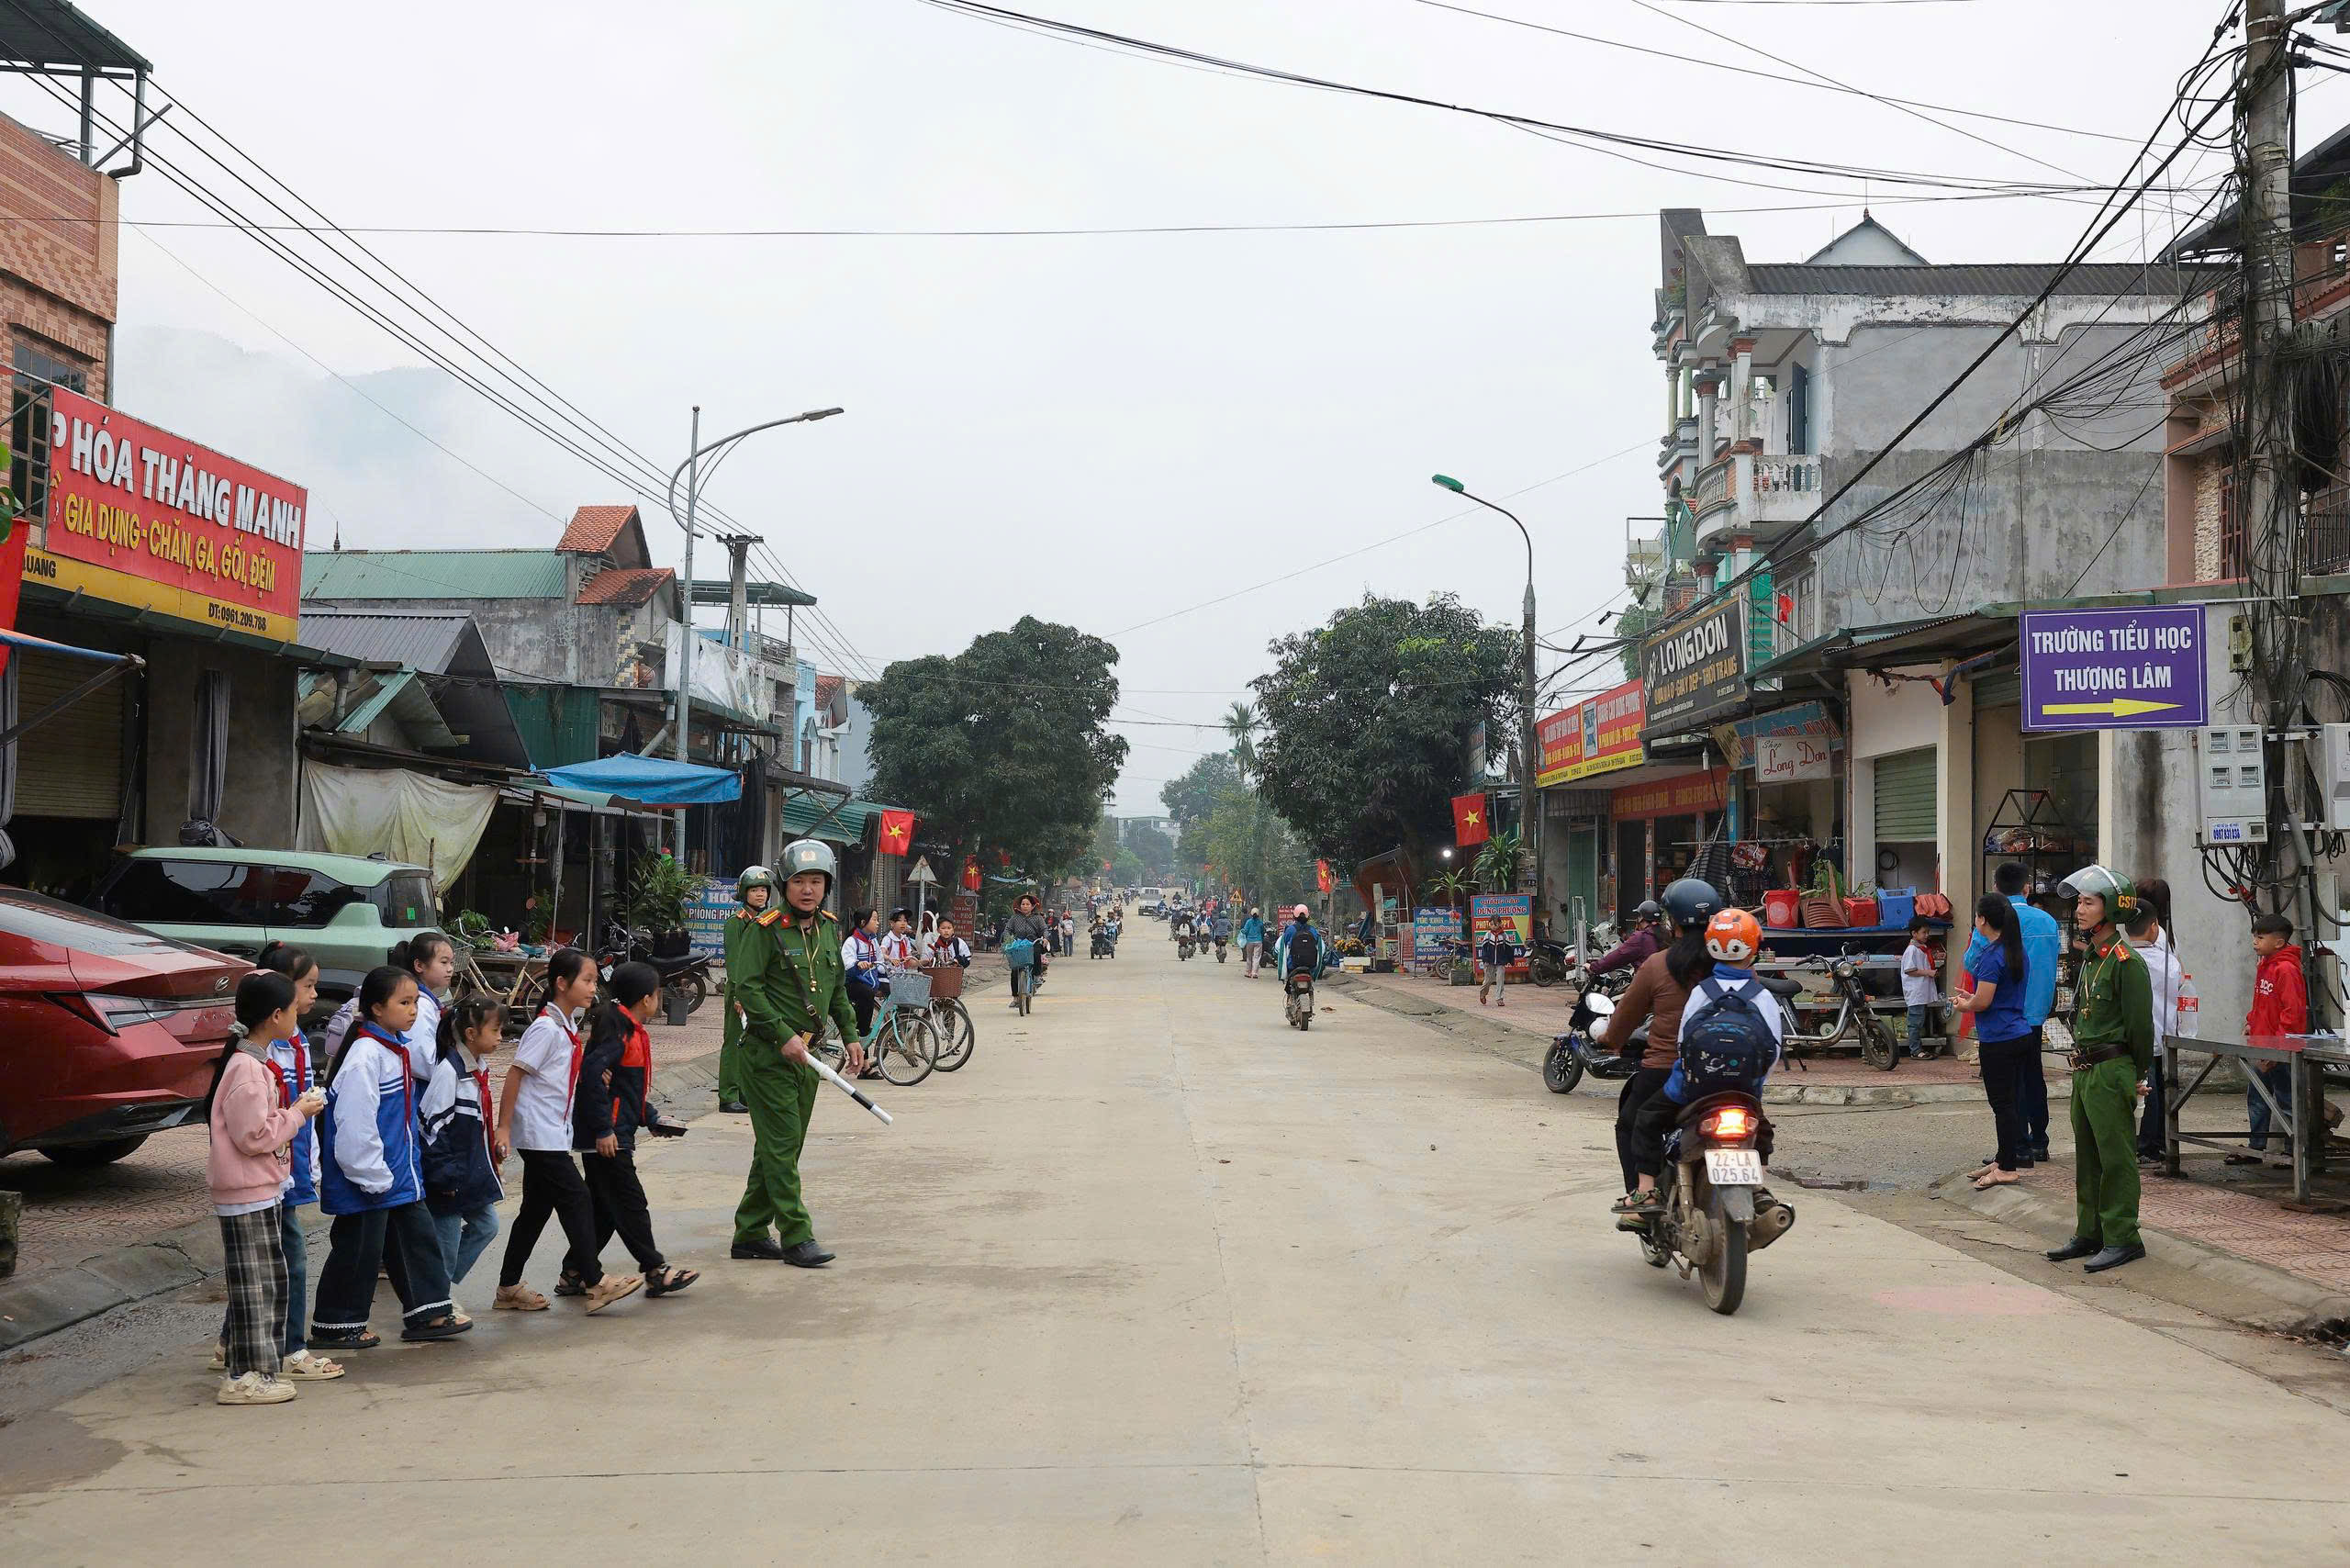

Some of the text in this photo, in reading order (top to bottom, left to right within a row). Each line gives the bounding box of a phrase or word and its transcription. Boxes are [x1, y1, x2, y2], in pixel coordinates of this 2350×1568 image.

[70, 415, 134, 493] HÓA
[65, 492, 94, 537] GIA
[196, 535, 218, 582] GA,
[221, 533, 247, 590] GỐI,
[249, 546, 276, 599] ĐỆM
[23, 554, 56, 578] UANG
[2031, 620, 2192, 654] TRƯỜNG TIỂU HỌC
[2054, 662, 2172, 695] THƯỢNG LÂM
[1762, 740, 1782, 749] Shop
[1763, 749, 1794, 776] Long
[688, 907, 717, 920] PHÒNG
[1514, 947, 1523, 956] A4
[1712, 1168, 1760, 1182] 025.64
